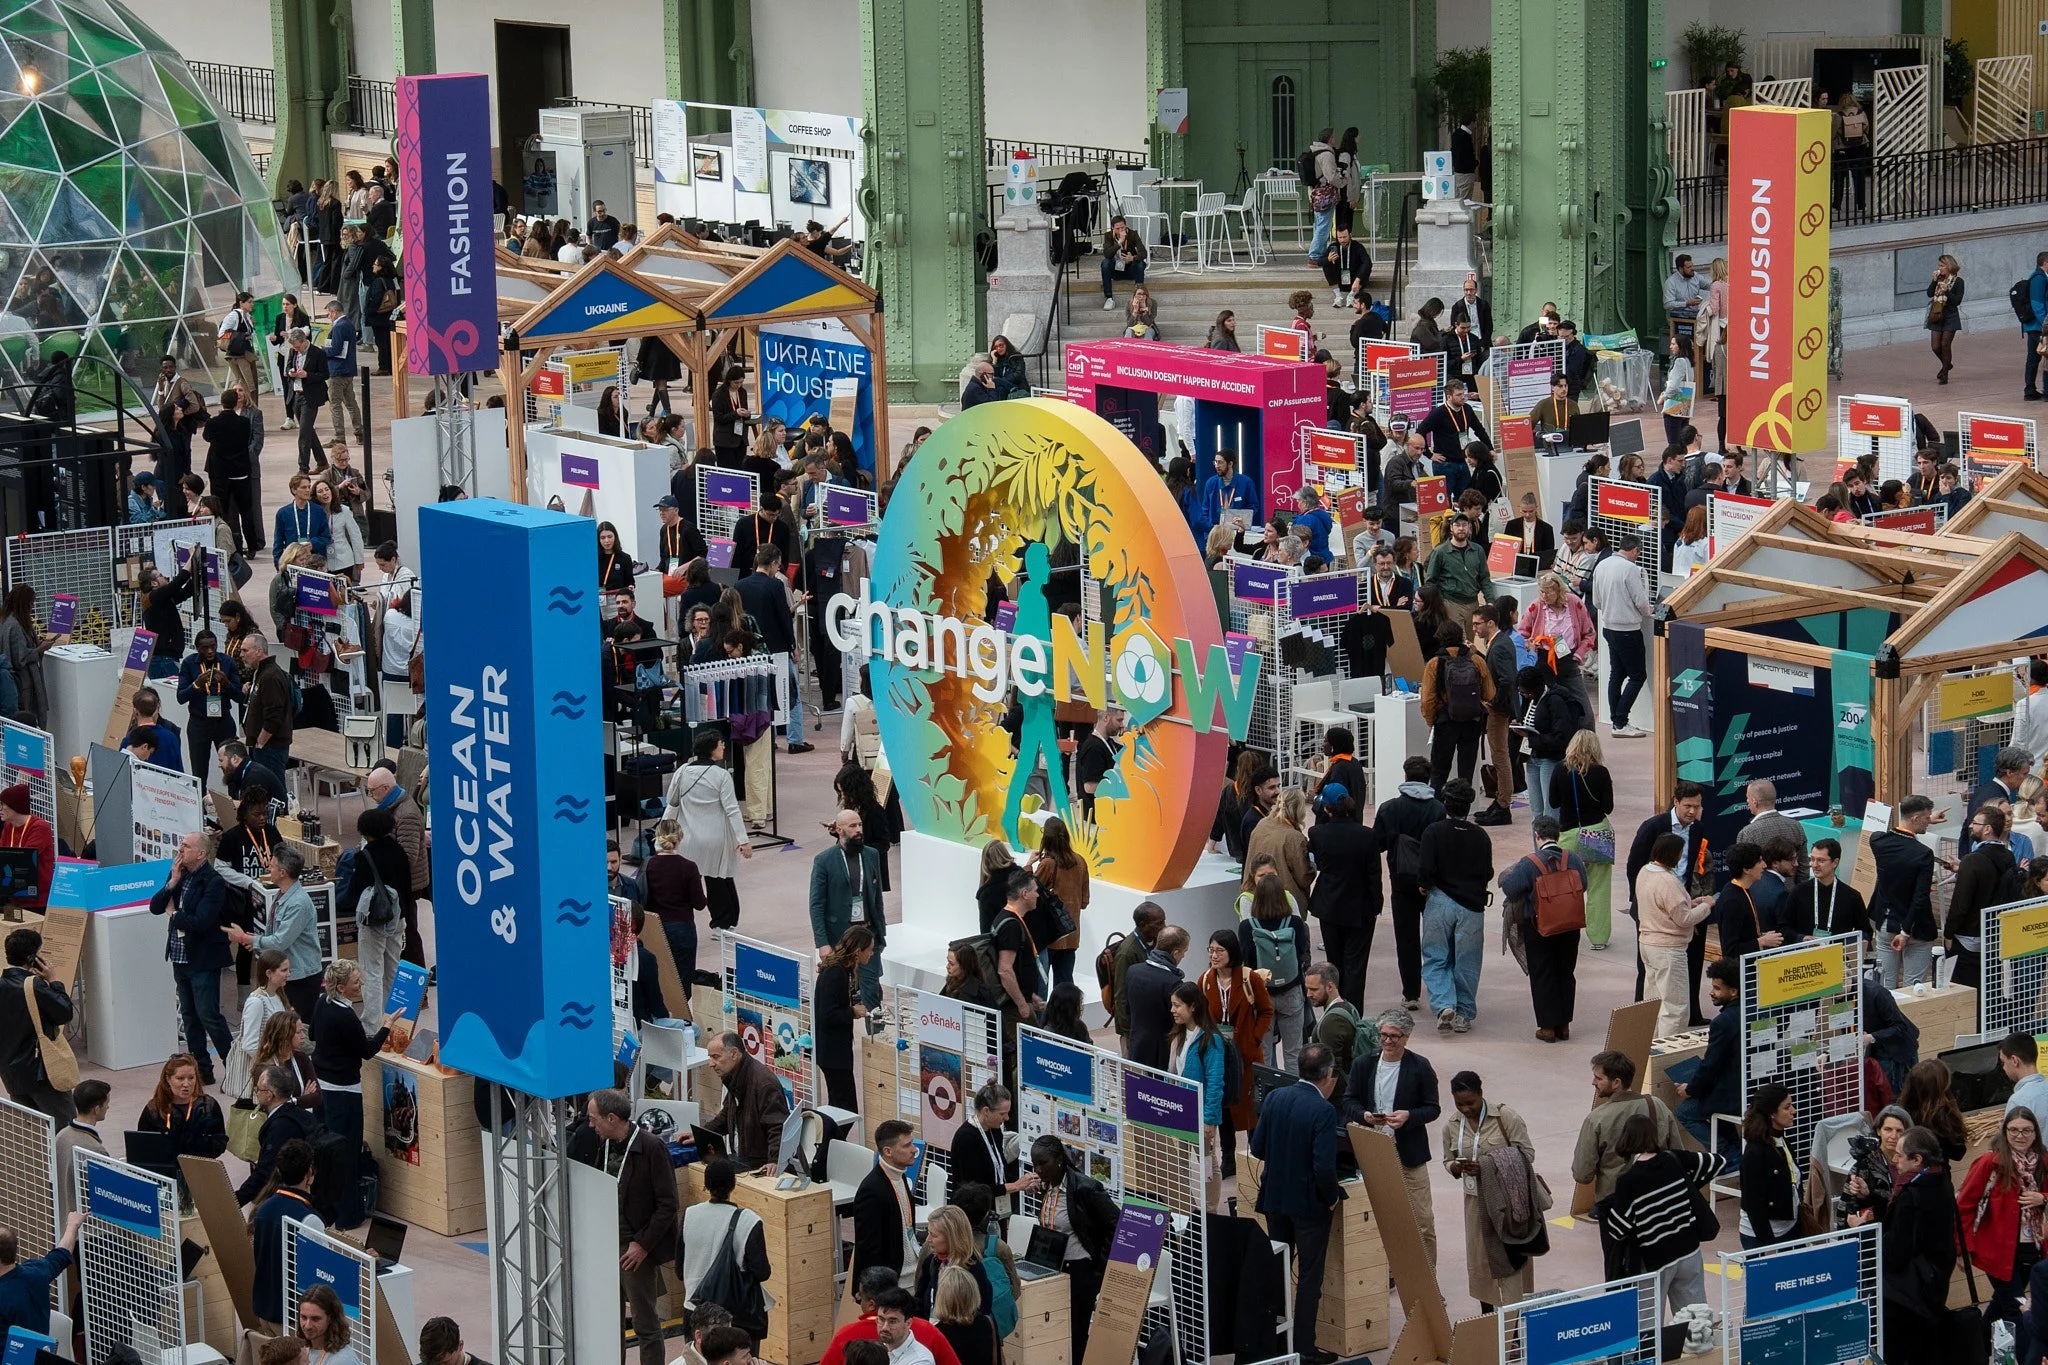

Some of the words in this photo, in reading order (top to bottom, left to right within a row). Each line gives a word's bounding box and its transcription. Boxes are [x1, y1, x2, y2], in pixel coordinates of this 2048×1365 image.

[788, 124, 808, 136] COFFEE
[809, 126, 832, 138] SHOP
[446, 152, 472, 296] FASHION
[1749, 177, 1772, 380] INCLUSION
[584, 302, 629, 316] UKRAINE
[765, 340, 867, 377] UKRAINE
[1069, 362, 1081, 371] CNP
[1117, 365, 1152, 380] INCLUSION
[1153, 371, 1183, 384] DOESN'T
[1183, 374, 1211, 388] HAPPEN
[1211, 379, 1222, 389] BY
[1221, 382, 1256, 395] ACCIDENT
[1268, 399, 1284, 409] CNP
[1284, 395, 1322, 407] Assurances
[1983, 433, 2009, 441] ENTOURAGE
[1721, 510, 1754, 522] INCLUSION?
[1913, 522, 1927, 532] SPACE
[1780, 667, 1791, 675] THE
[1790, 668, 1809, 679] HAGUE
[1682, 679, 1694, 691] 13
[1840, 710, 1865, 725] 200+
[1733, 733, 1746, 741] City
[1754, 729, 1772, 738] peace
[1778, 724, 1798, 735] justice
[1733, 755, 1754, 764] Access
[1762, 750, 1783, 760] capital
[482, 664, 515, 883] WATER
[1777, 771, 1802, 780] network
[448, 683, 483, 906] OCEAN
[1782, 791, 1822, 804] development
[109, 879, 155, 893] FRIENDSFAIR
[490, 903, 518, 945] &
[1777, 968, 1828, 984] INTERNATIONAL
[1783, 961, 1824, 976] IN-BETWEEN
[1036, 1056, 1073, 1075] SWIM2CORAL
[1137, 1091, 1184, 1113] EWS-RICEFARMS
[94, 1185, 124, 1206] LEVIATHAN
[122, 1197, 153, 1214] DYNAMICS
[1775, 1279, 1799, 1292] FREE
[1798, 1275, 1815, 1287] THE
[1815, 1272, 1832, 1284] SEA
[1557, 1327, 1582, 1341] PURE
[1581, 1320, 1612, 1336] OCEAN
